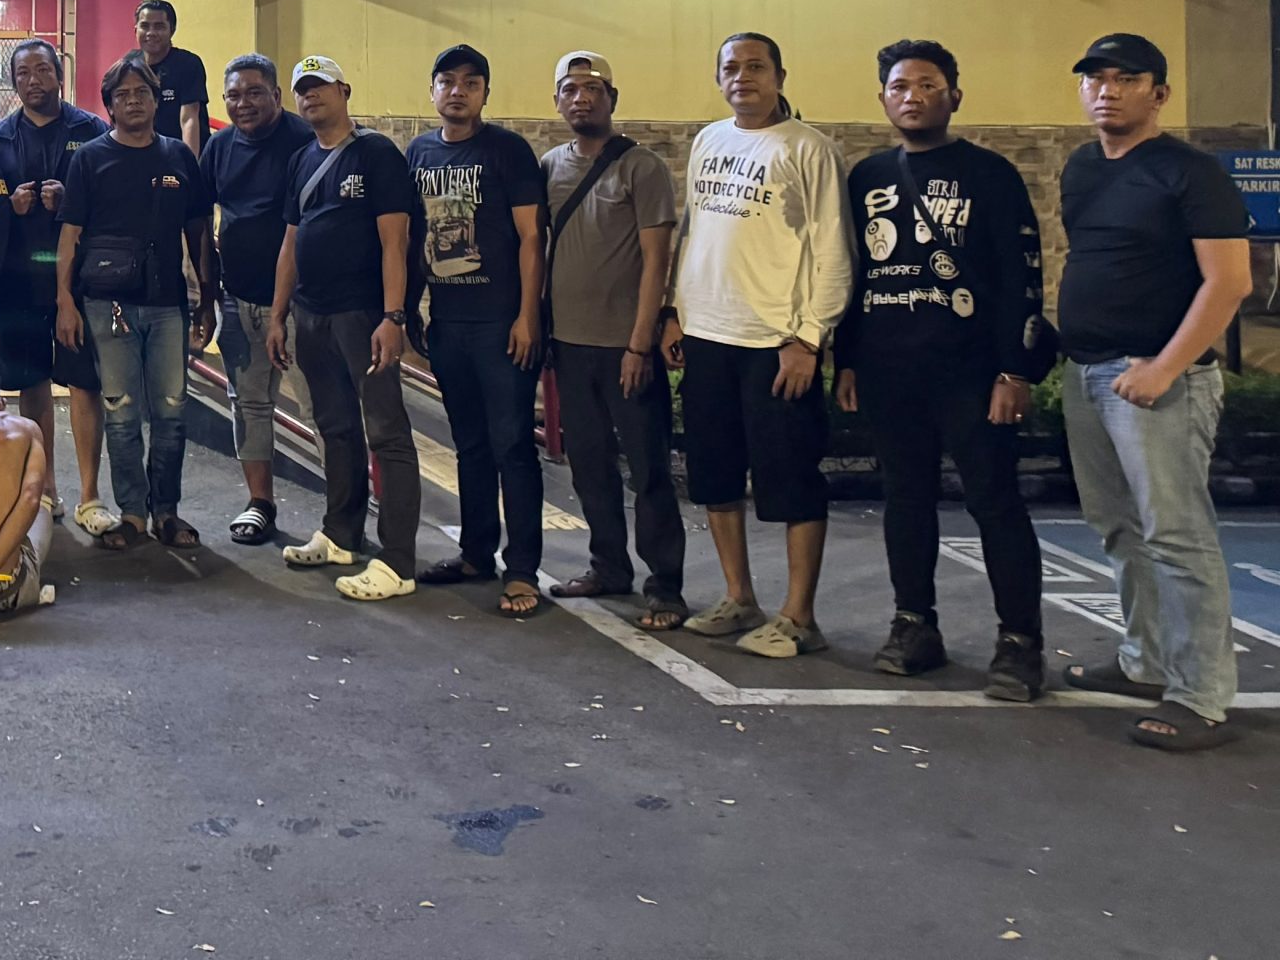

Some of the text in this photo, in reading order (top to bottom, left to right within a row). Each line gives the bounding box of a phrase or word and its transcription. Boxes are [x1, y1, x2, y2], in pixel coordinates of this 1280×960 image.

[700, 156, 766, 186] FAMILIA
[1234, 157, 1253, 169] SAT
[415, 165, 482, 203] CONVERSE
